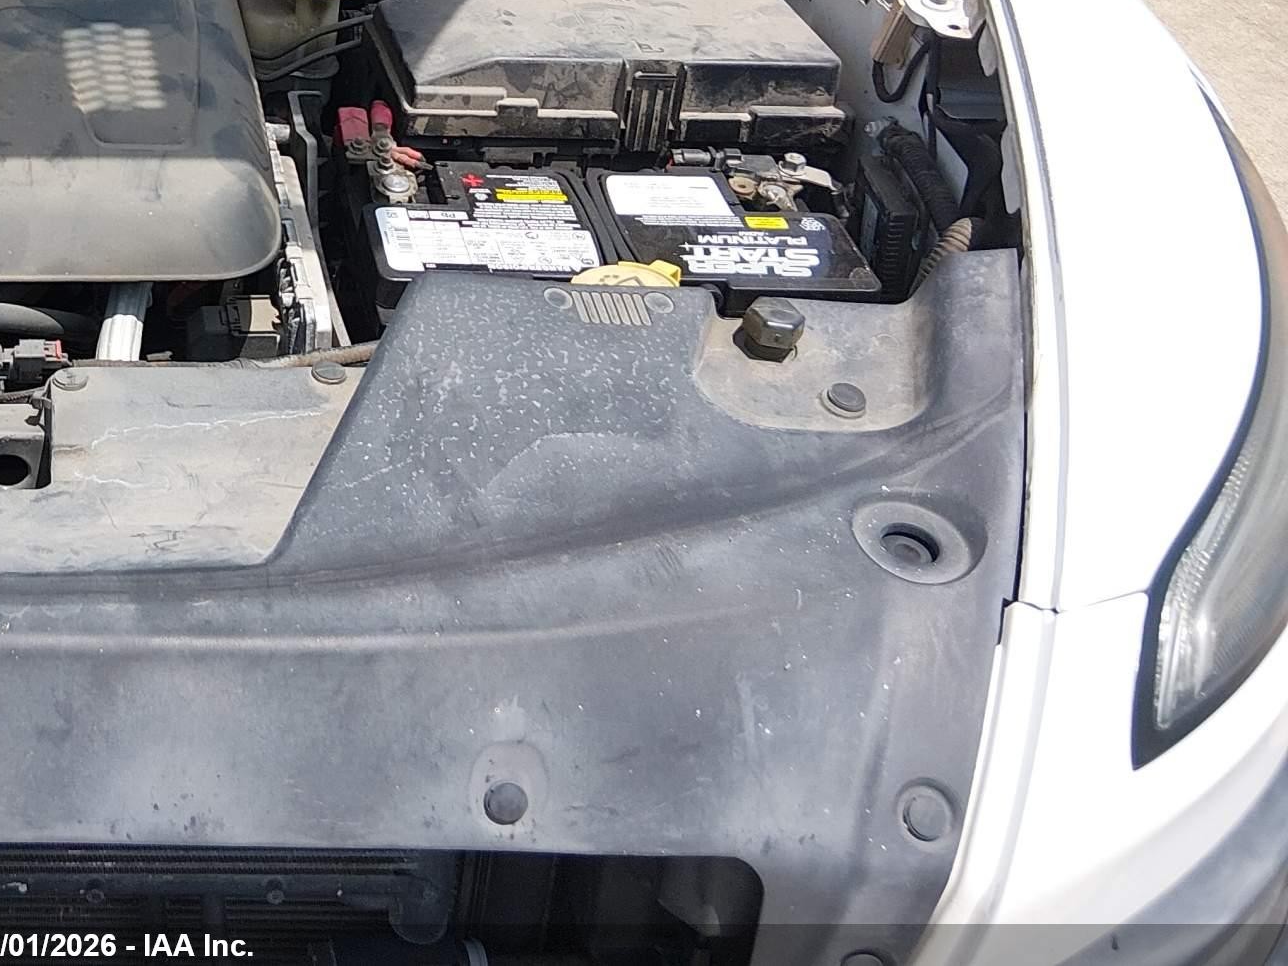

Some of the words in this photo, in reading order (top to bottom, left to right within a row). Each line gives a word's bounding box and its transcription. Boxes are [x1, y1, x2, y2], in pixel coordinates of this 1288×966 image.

[697, 234, 808, 246] PLATINUM
[680, 247, 820, 267] START
[687, 260, 813, 278] SUPER
